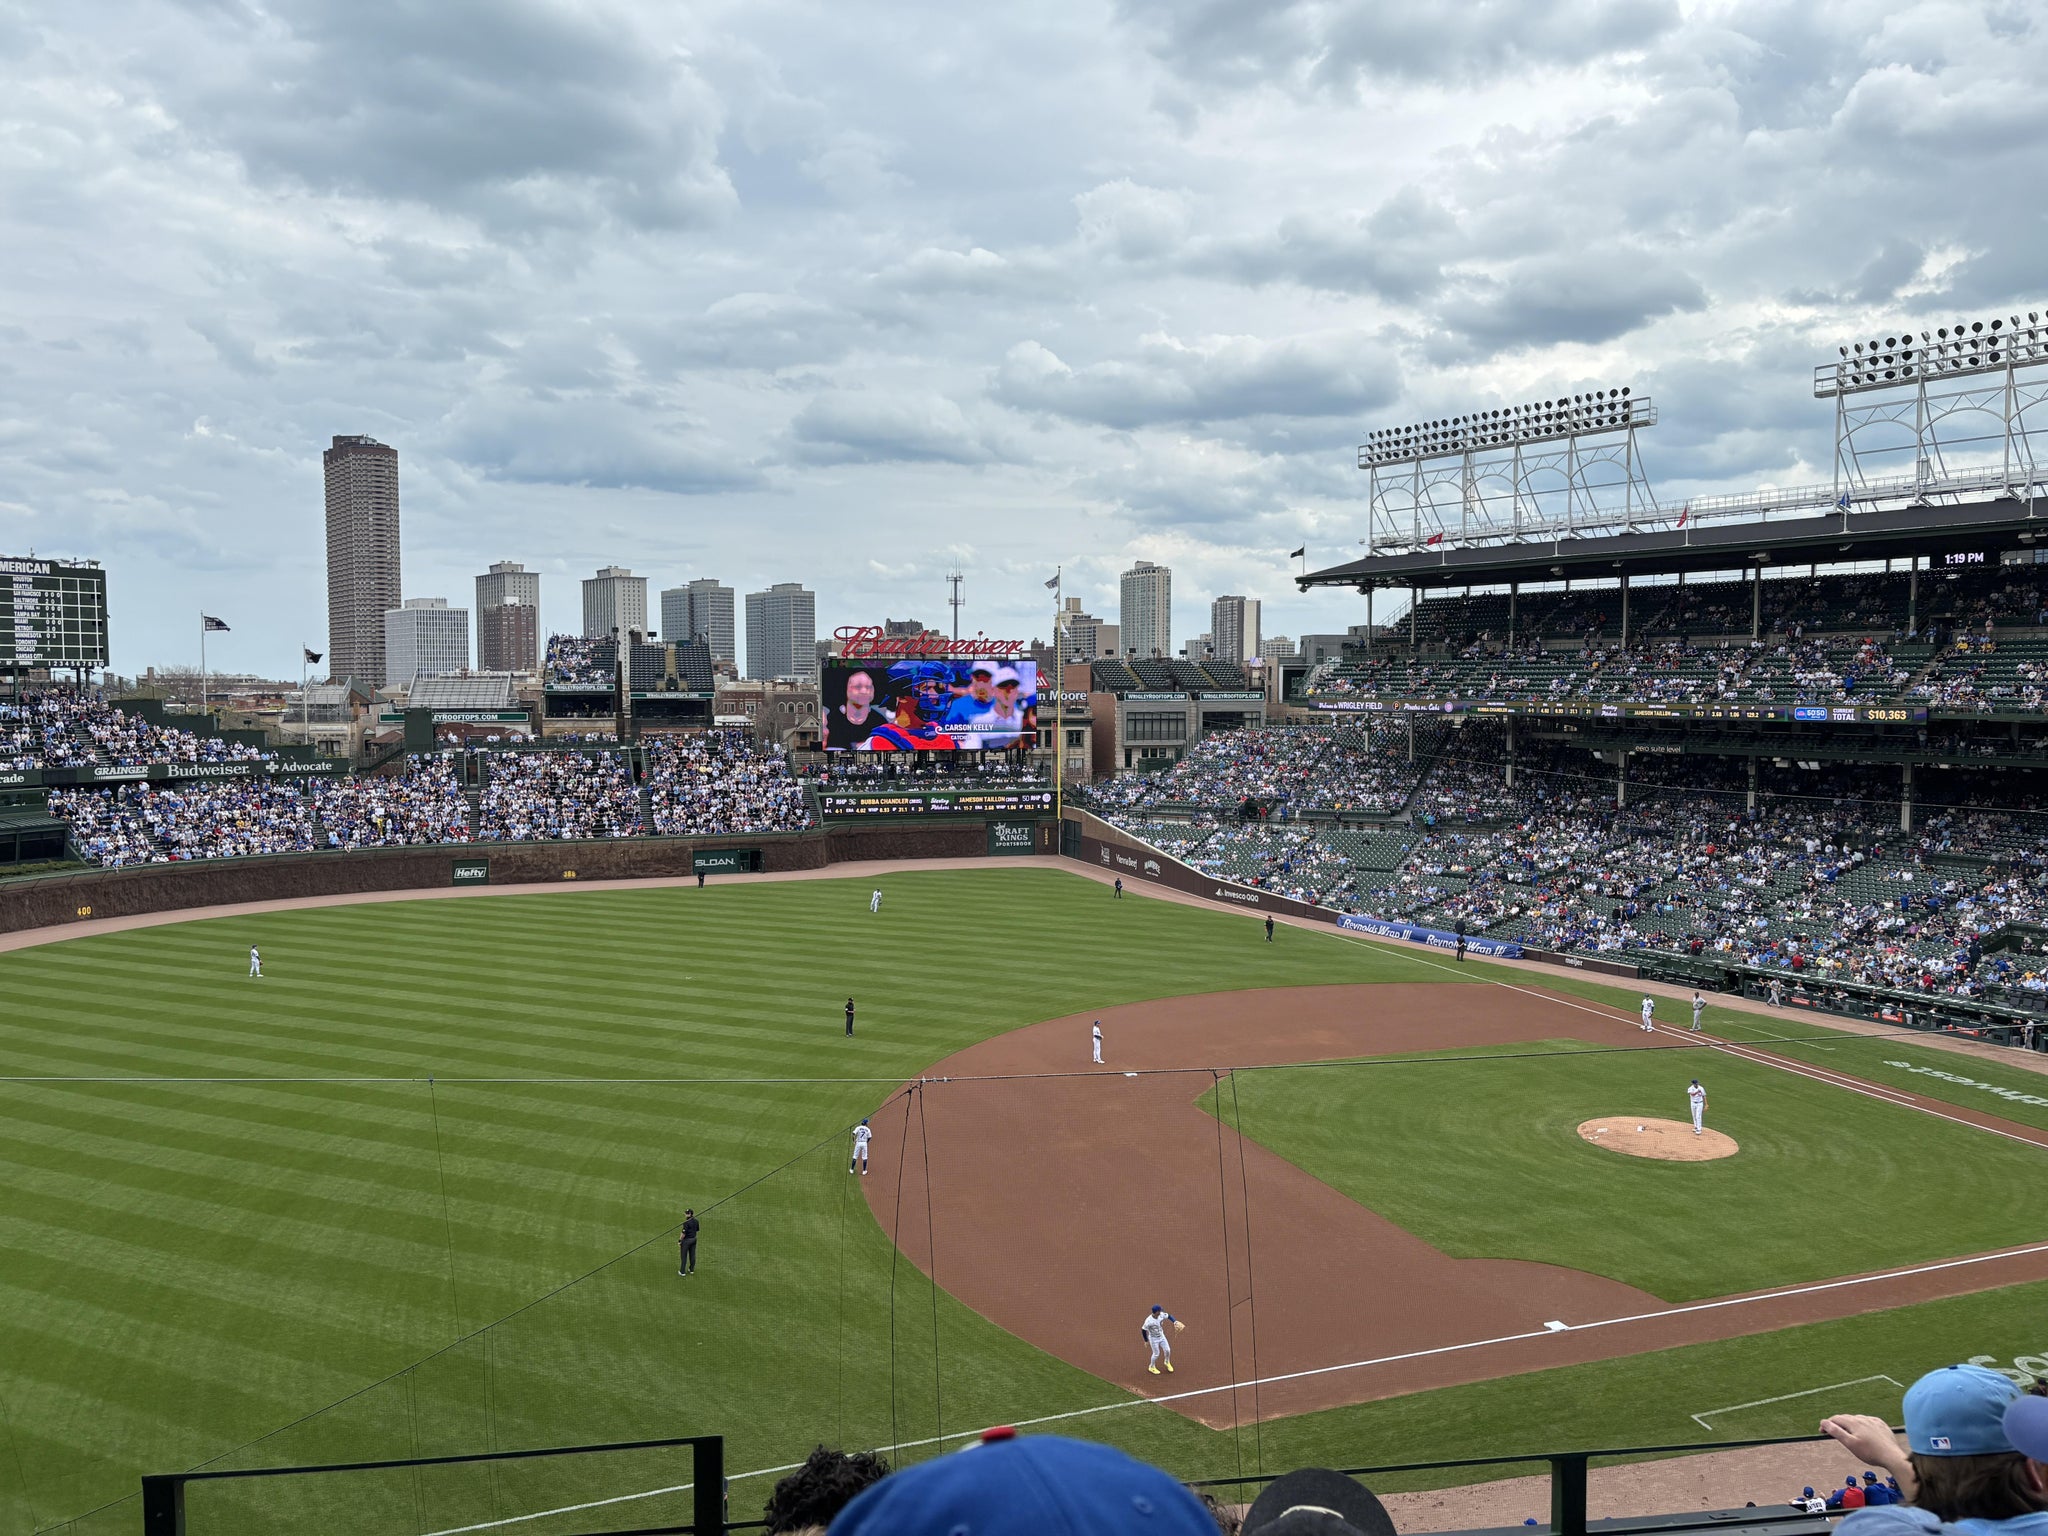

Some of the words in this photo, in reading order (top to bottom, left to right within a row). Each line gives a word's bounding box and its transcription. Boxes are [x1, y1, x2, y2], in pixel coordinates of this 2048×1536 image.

[1945, 553, 1965, 564] 1:19
[1968, 552, 1984, 562] PM
[834, 626, 1024, 657] Budweiser
[1050, 690, 1087, 700] Moore
[1868, 710, 1906, 720] $10,363
[94, 766, 148, 776] GRAINGER
[168, 764, 248, 777] Budweiser
[281, 761, 332, 772] Advocate
[996, 828, 1029, 836] DRAFT
[457, 868, 485, 878] Hefty
[1224, 889, 1246, 900] Invesco
[77, 906, 92, 916] 400
[1342, 918, 1378, 934] Reynolds
[1378, 925, 1400, 939] Wrap
[1466, 941, 1490, 955] Wrap
